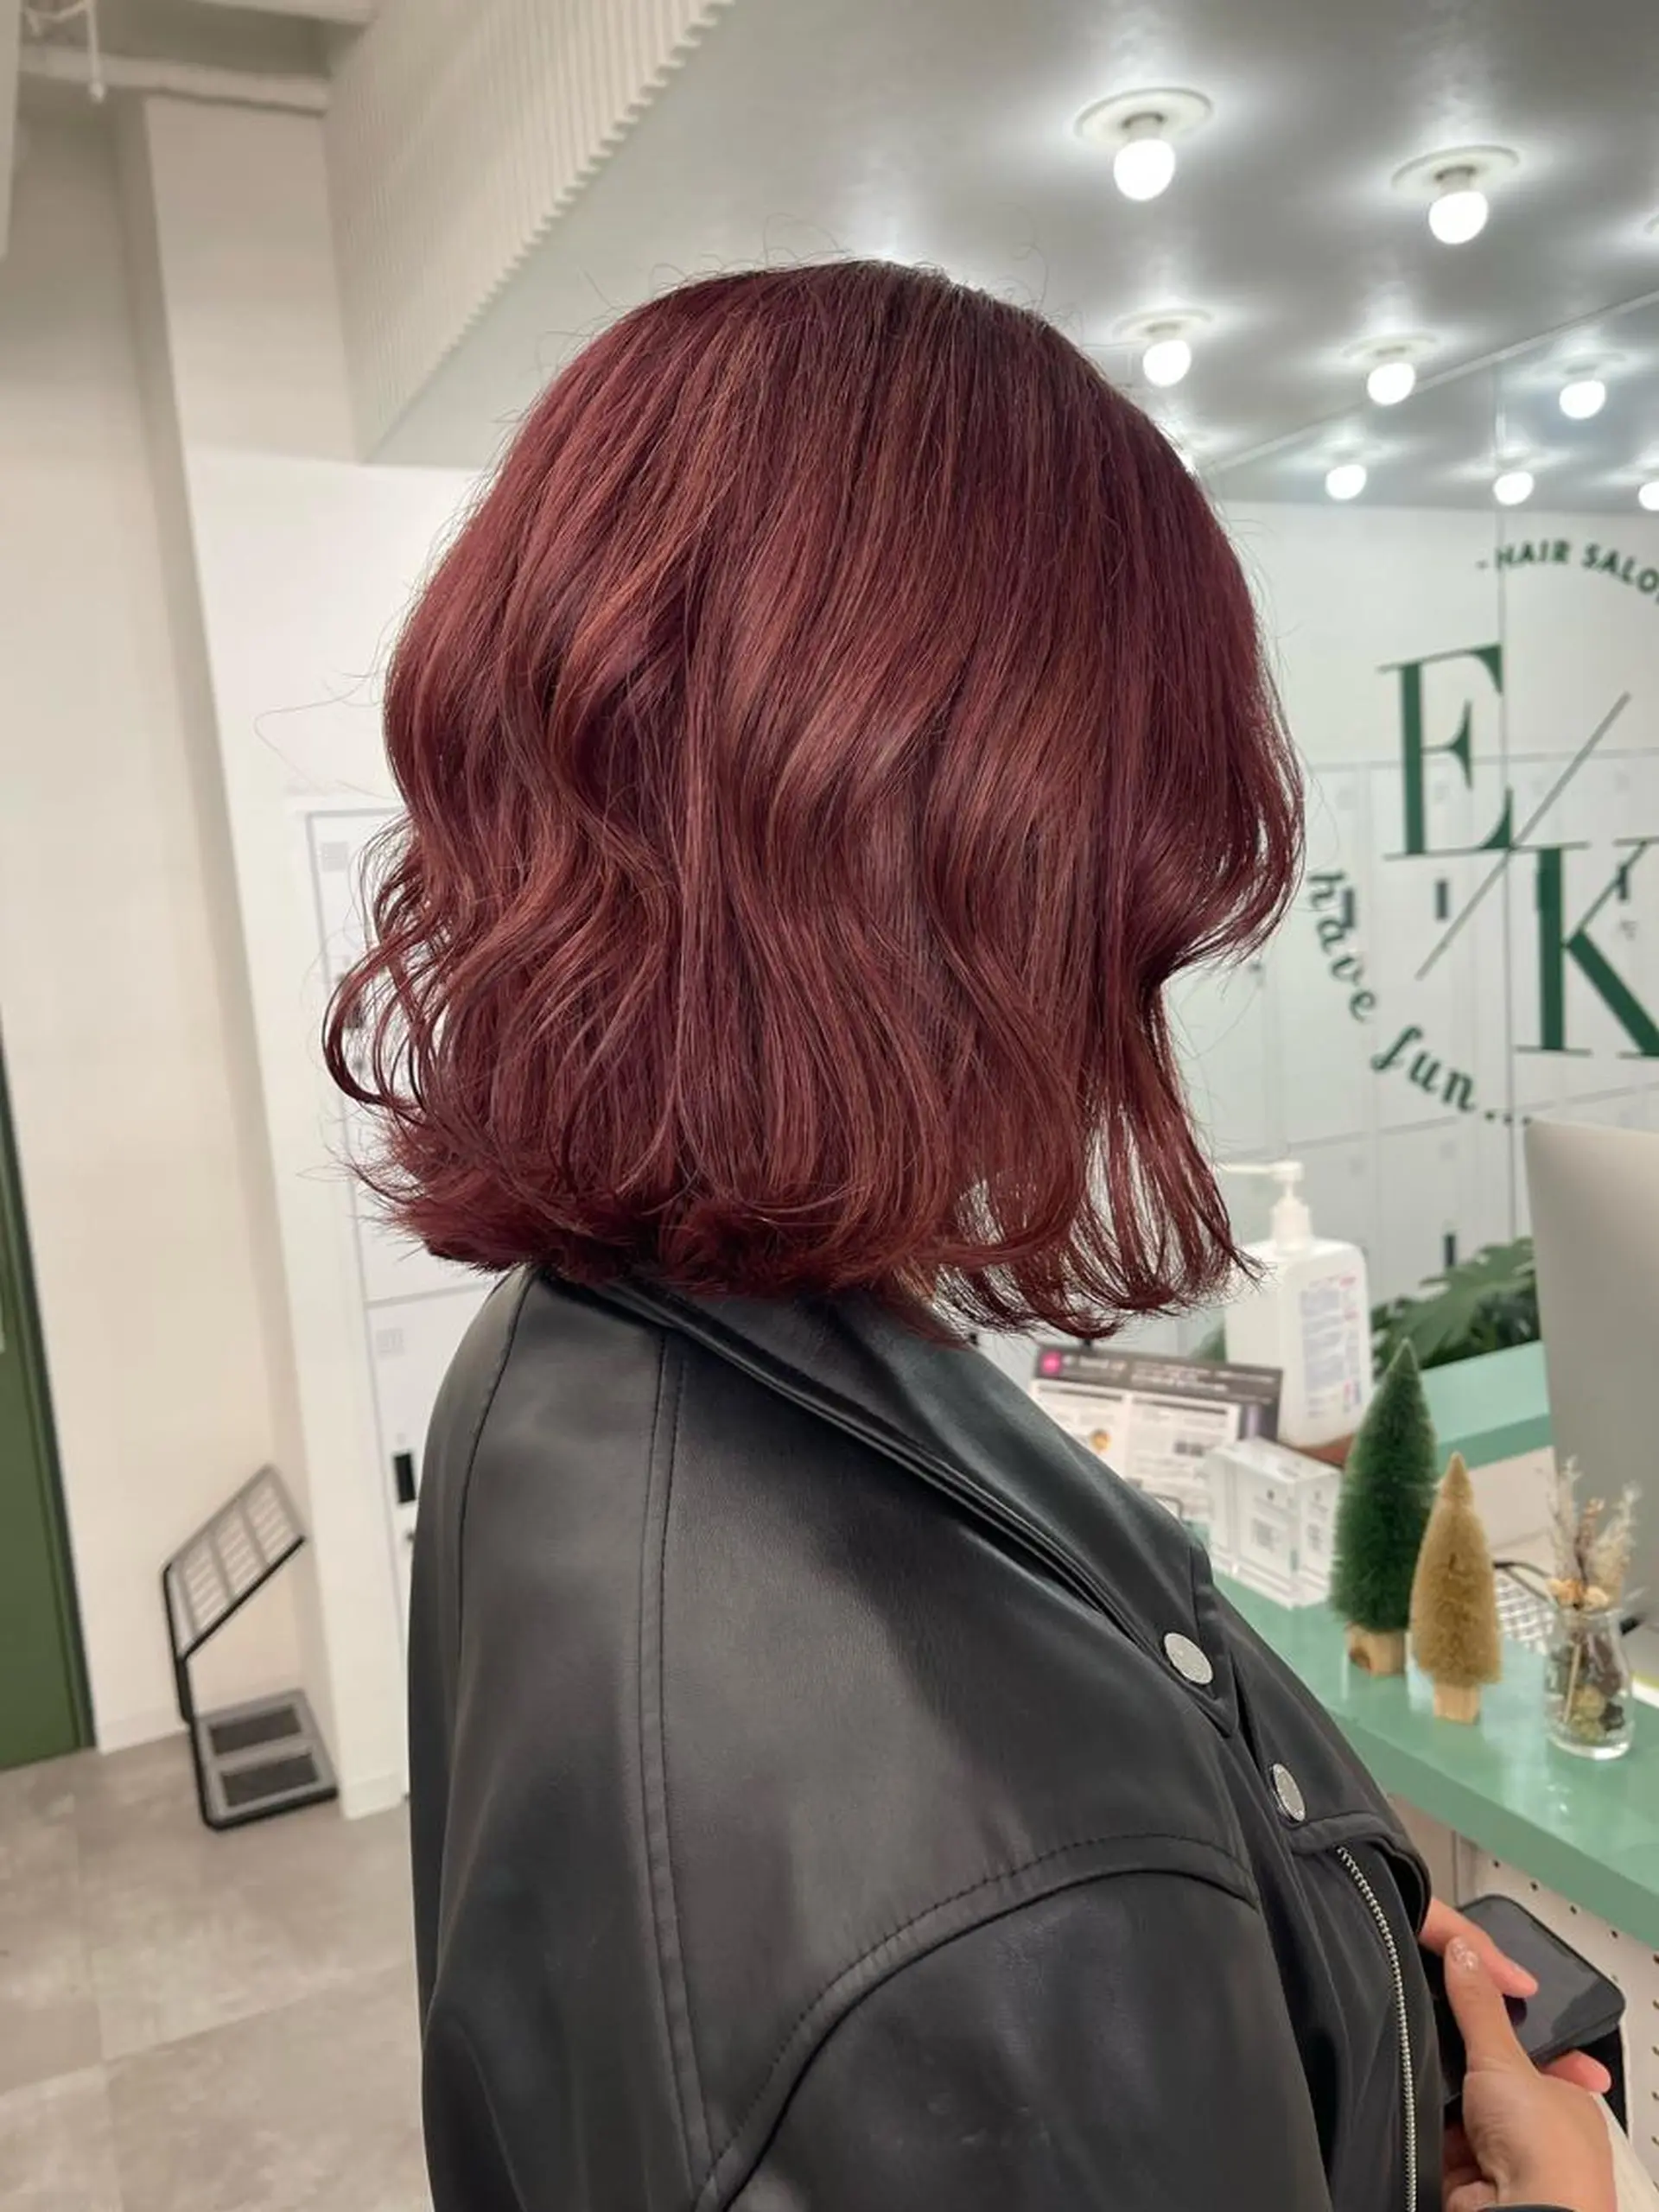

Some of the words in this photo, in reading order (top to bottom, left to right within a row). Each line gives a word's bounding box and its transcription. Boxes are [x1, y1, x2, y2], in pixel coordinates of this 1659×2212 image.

[1494, 539, 1569, 571] HAIR
[1582, 543, 1659, 605] SALO
[1306, 868, 1376, 1022] have
